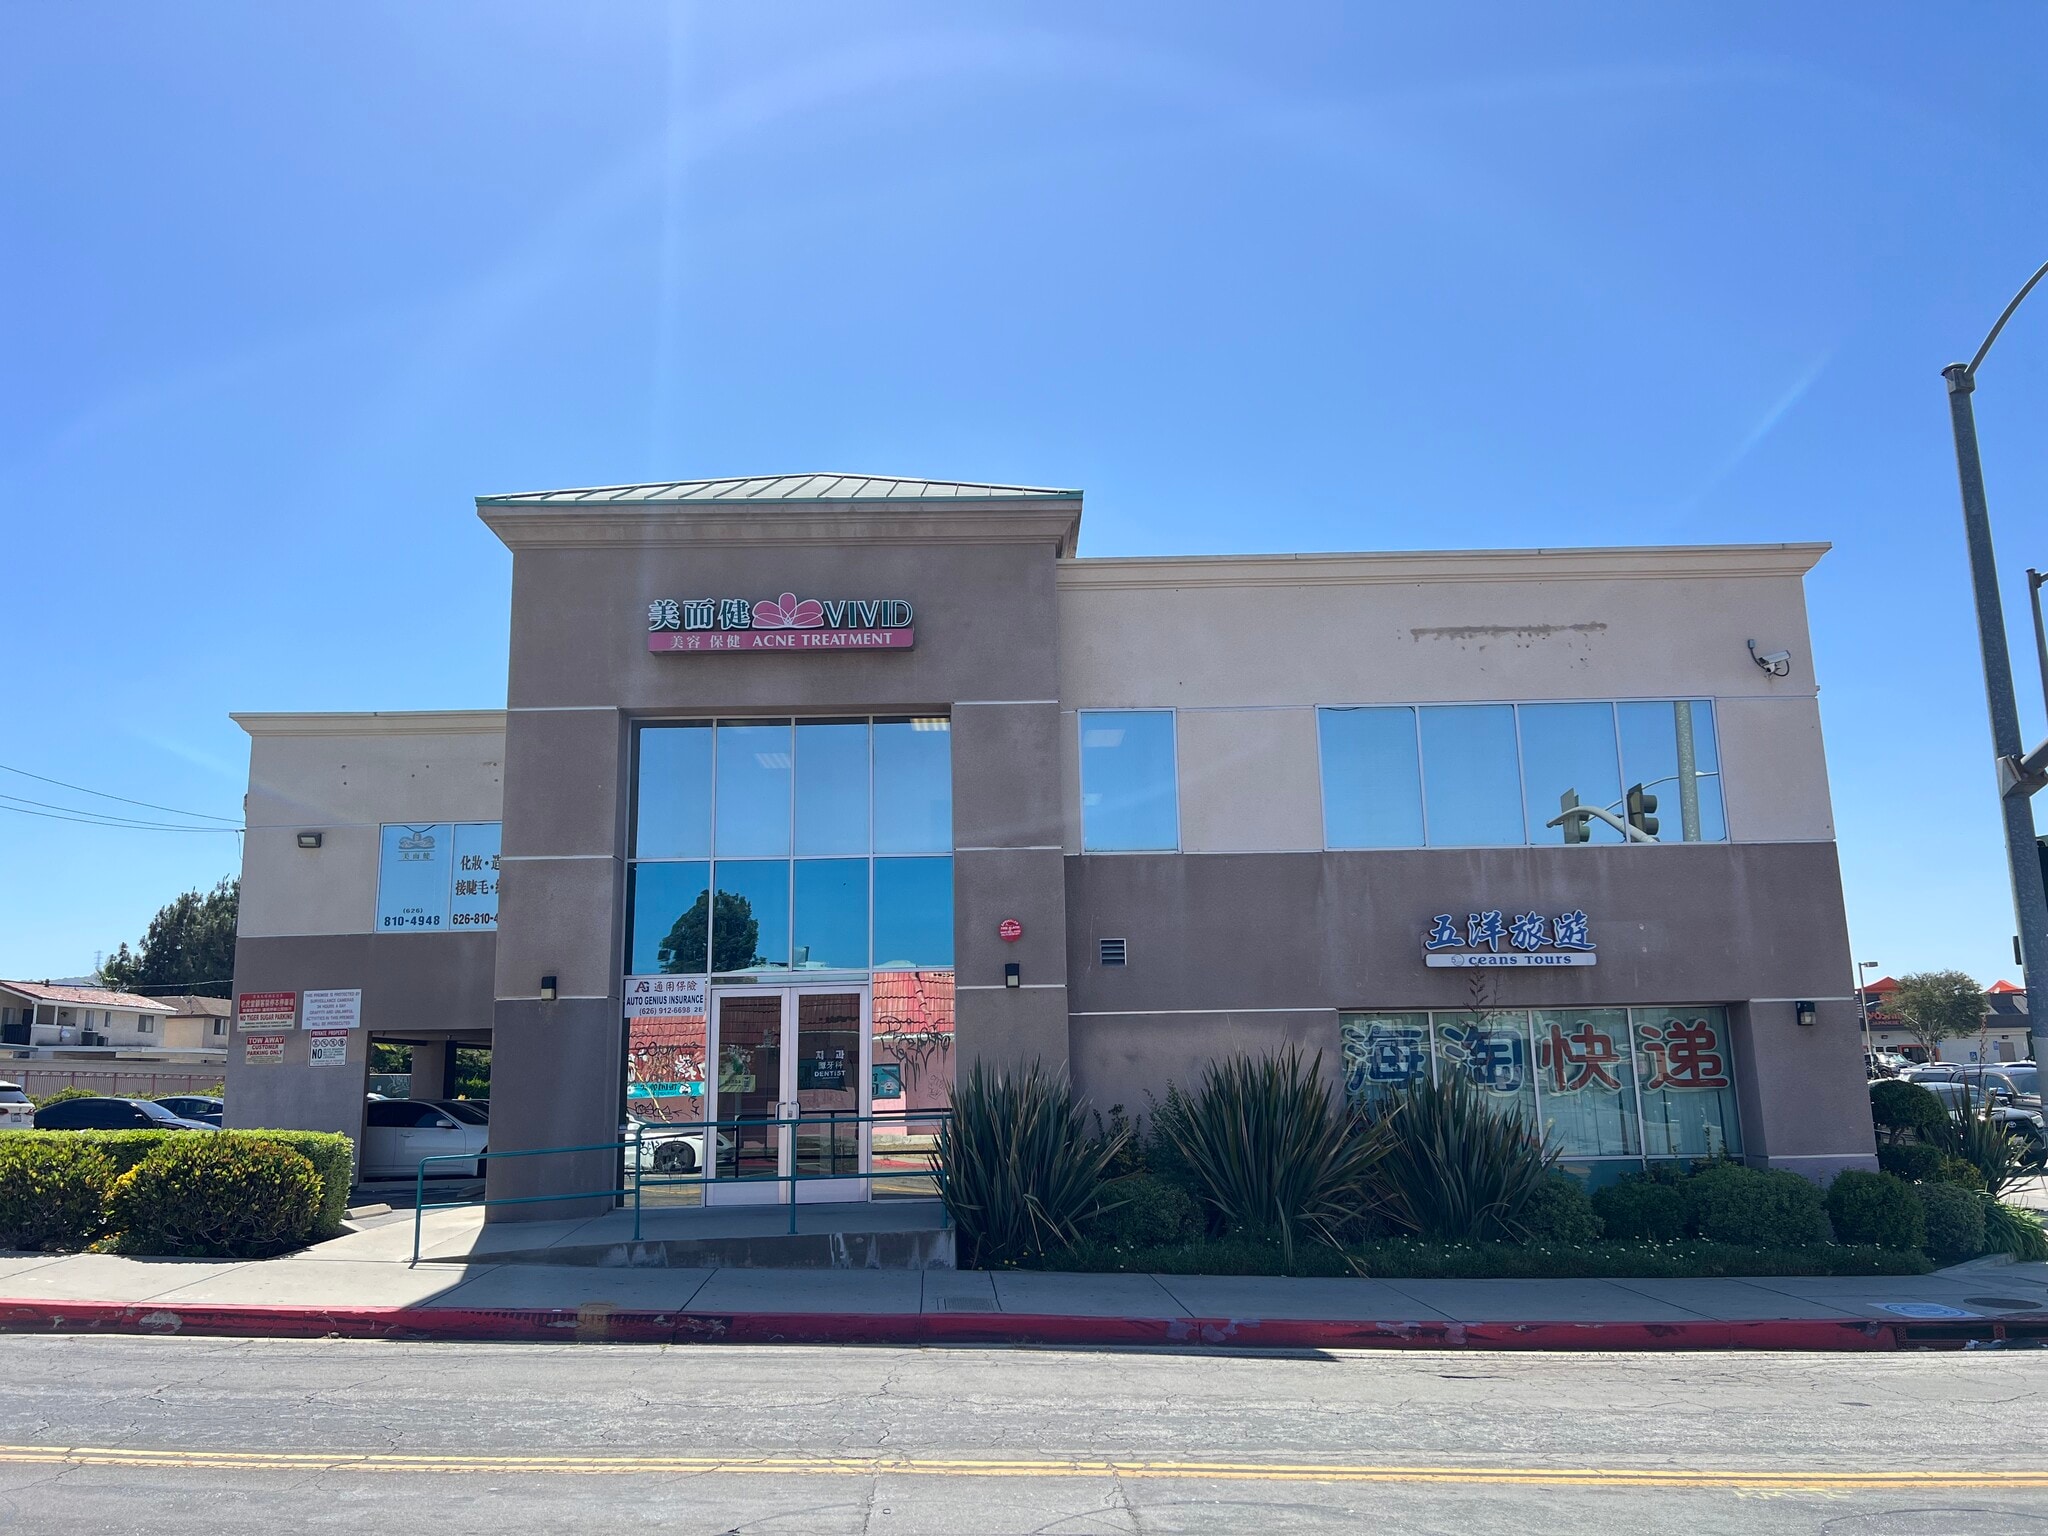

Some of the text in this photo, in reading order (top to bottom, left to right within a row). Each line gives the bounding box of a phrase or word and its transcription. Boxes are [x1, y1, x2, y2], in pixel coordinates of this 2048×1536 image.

[823, 599, 913, 628] VIVID
[671, 634, 740, 649] 美容 保健
[752, 632, 893, 647] ACNE TREATMENT
[384, 915, 440, 926] 810-4948
[1425, 910, 1597, 952] 五洋旅遊
[626, 994, 704, 1006] AUTO GENIUS INSURANCE
[639, 1007, 657, 1015] (626)
[265, 1036, 284, 1044] AWAY
[311, 1048, 323, 1060] NO
